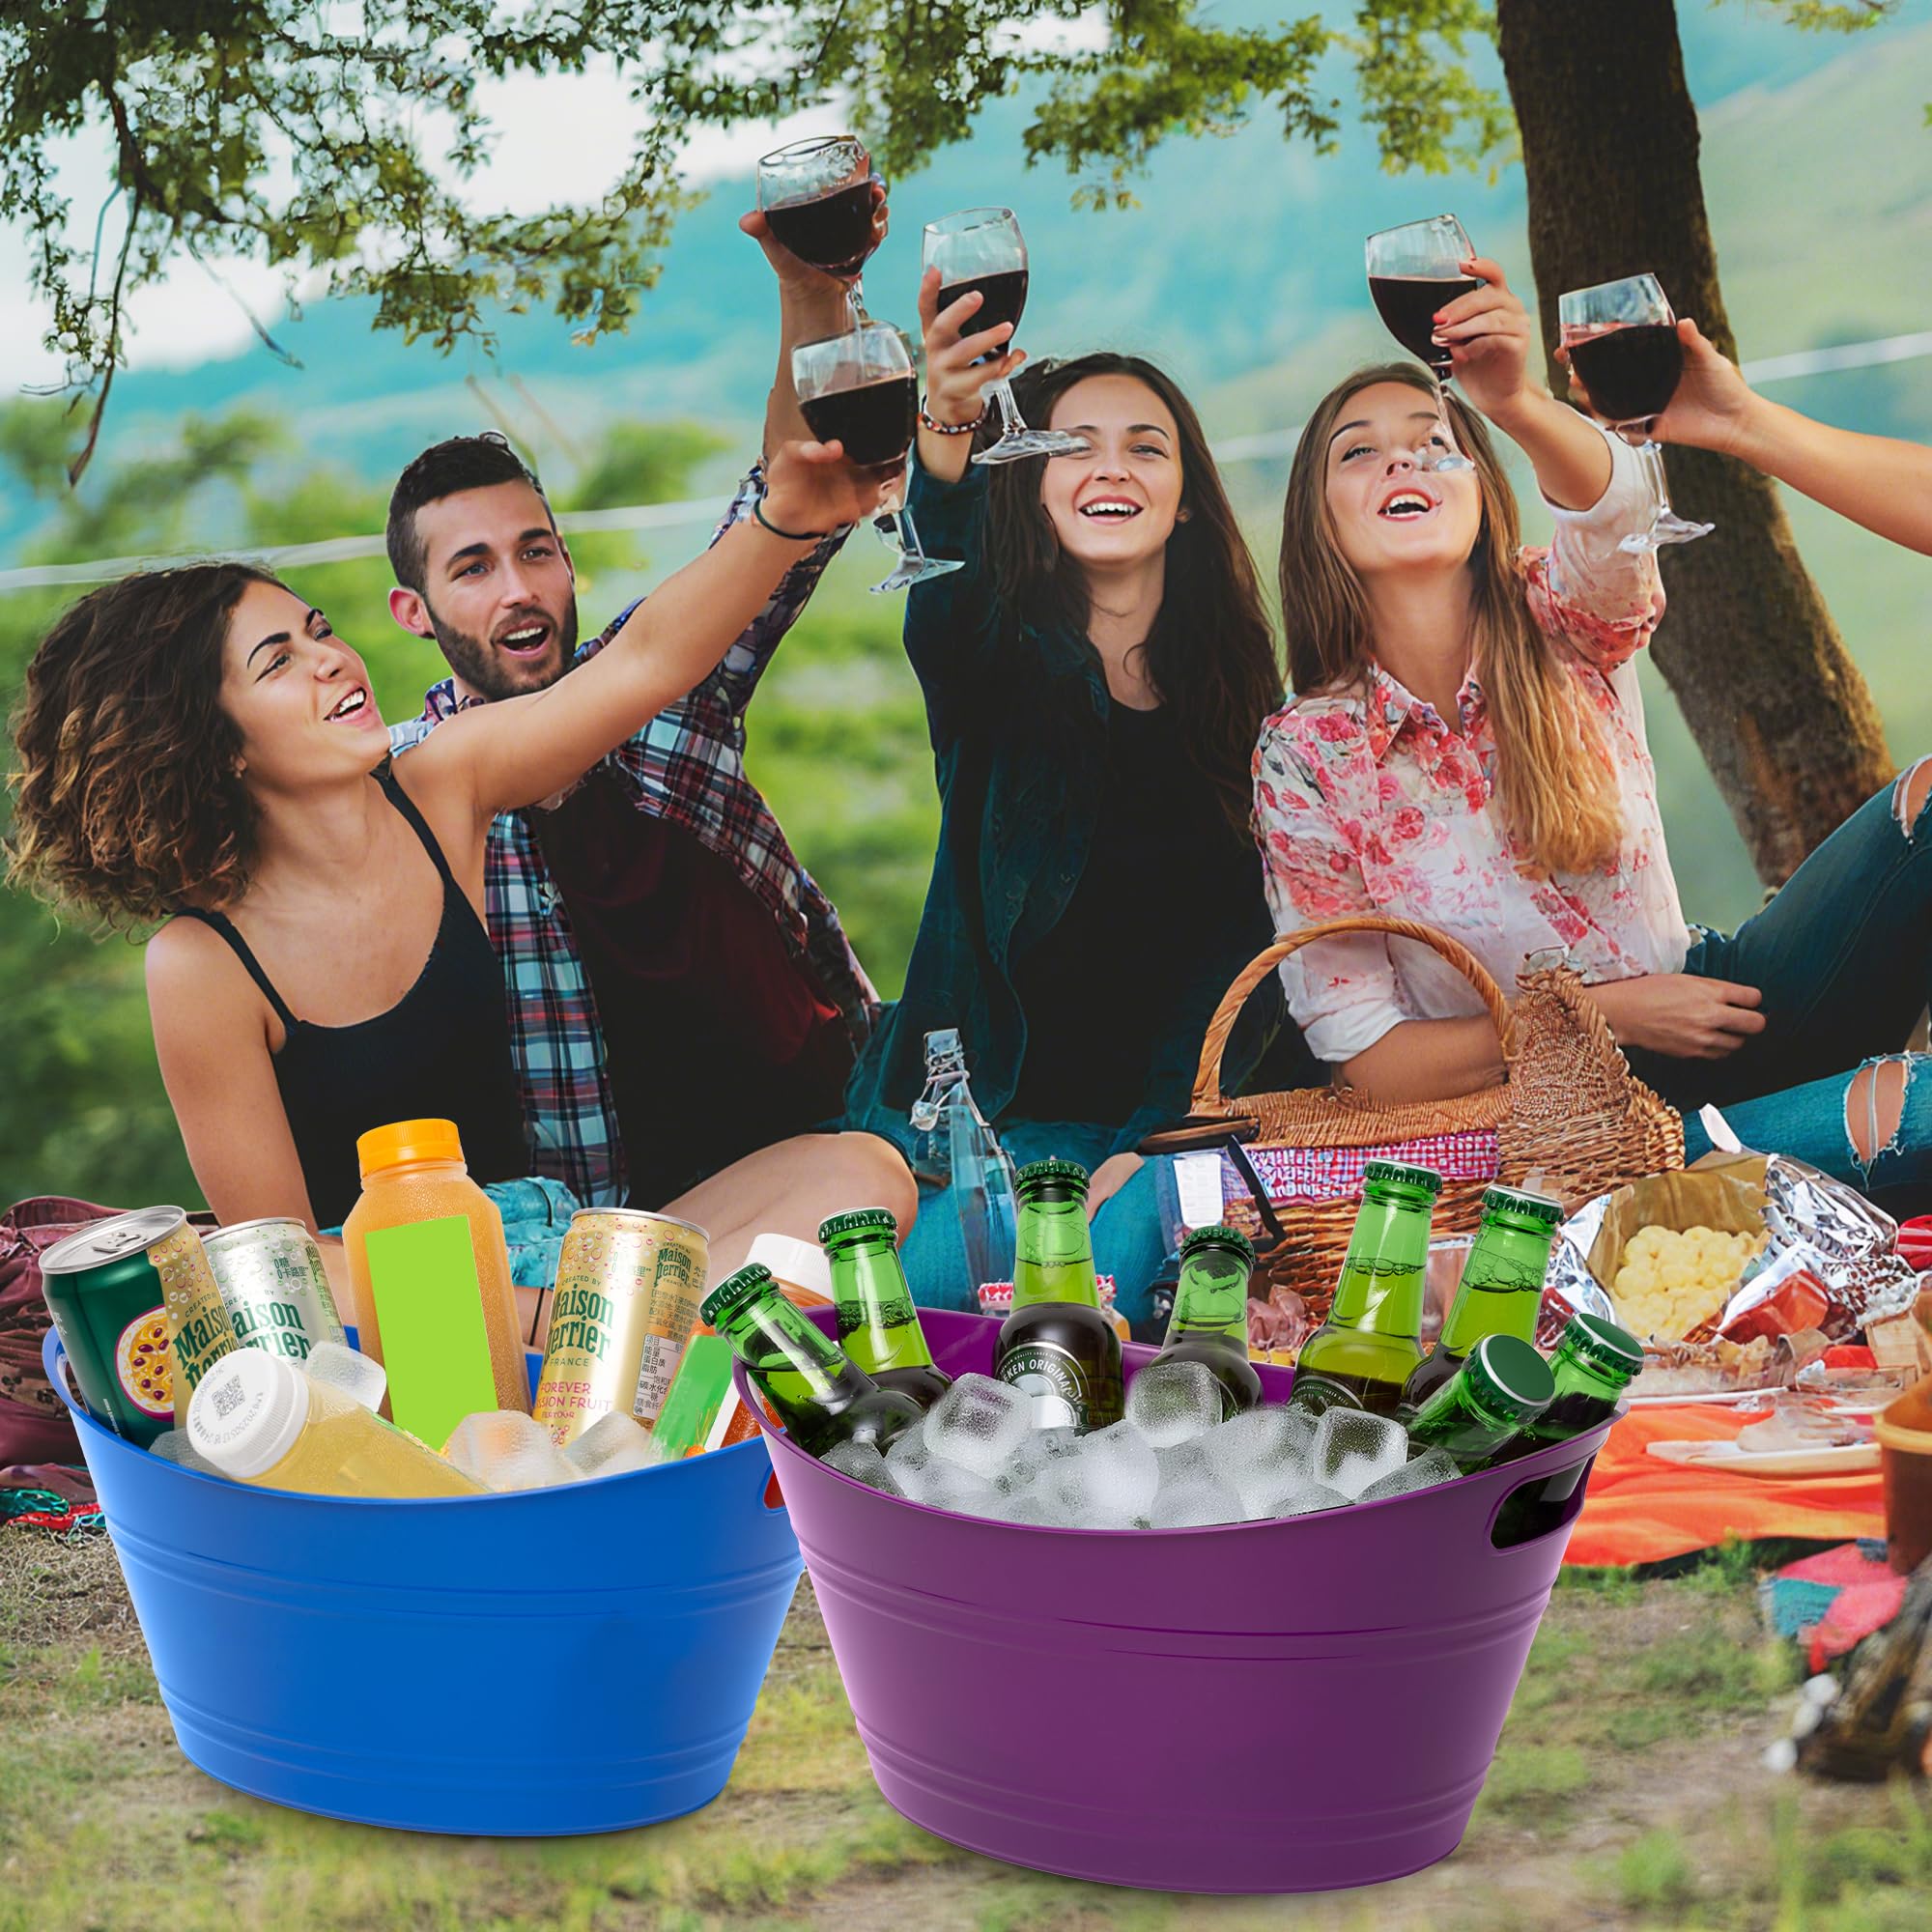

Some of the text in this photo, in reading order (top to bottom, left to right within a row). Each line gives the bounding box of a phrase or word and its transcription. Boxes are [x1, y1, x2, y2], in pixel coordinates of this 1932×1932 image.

[657, 1247, 692, 1273] Maison
[591, 1277, 601, 1287] BY
[550, 1357, 590, 1367] FRANCE
[642, 1354, 666, 1368] 蛋白质
[641, 1364, 657, 1375] 脂肪
